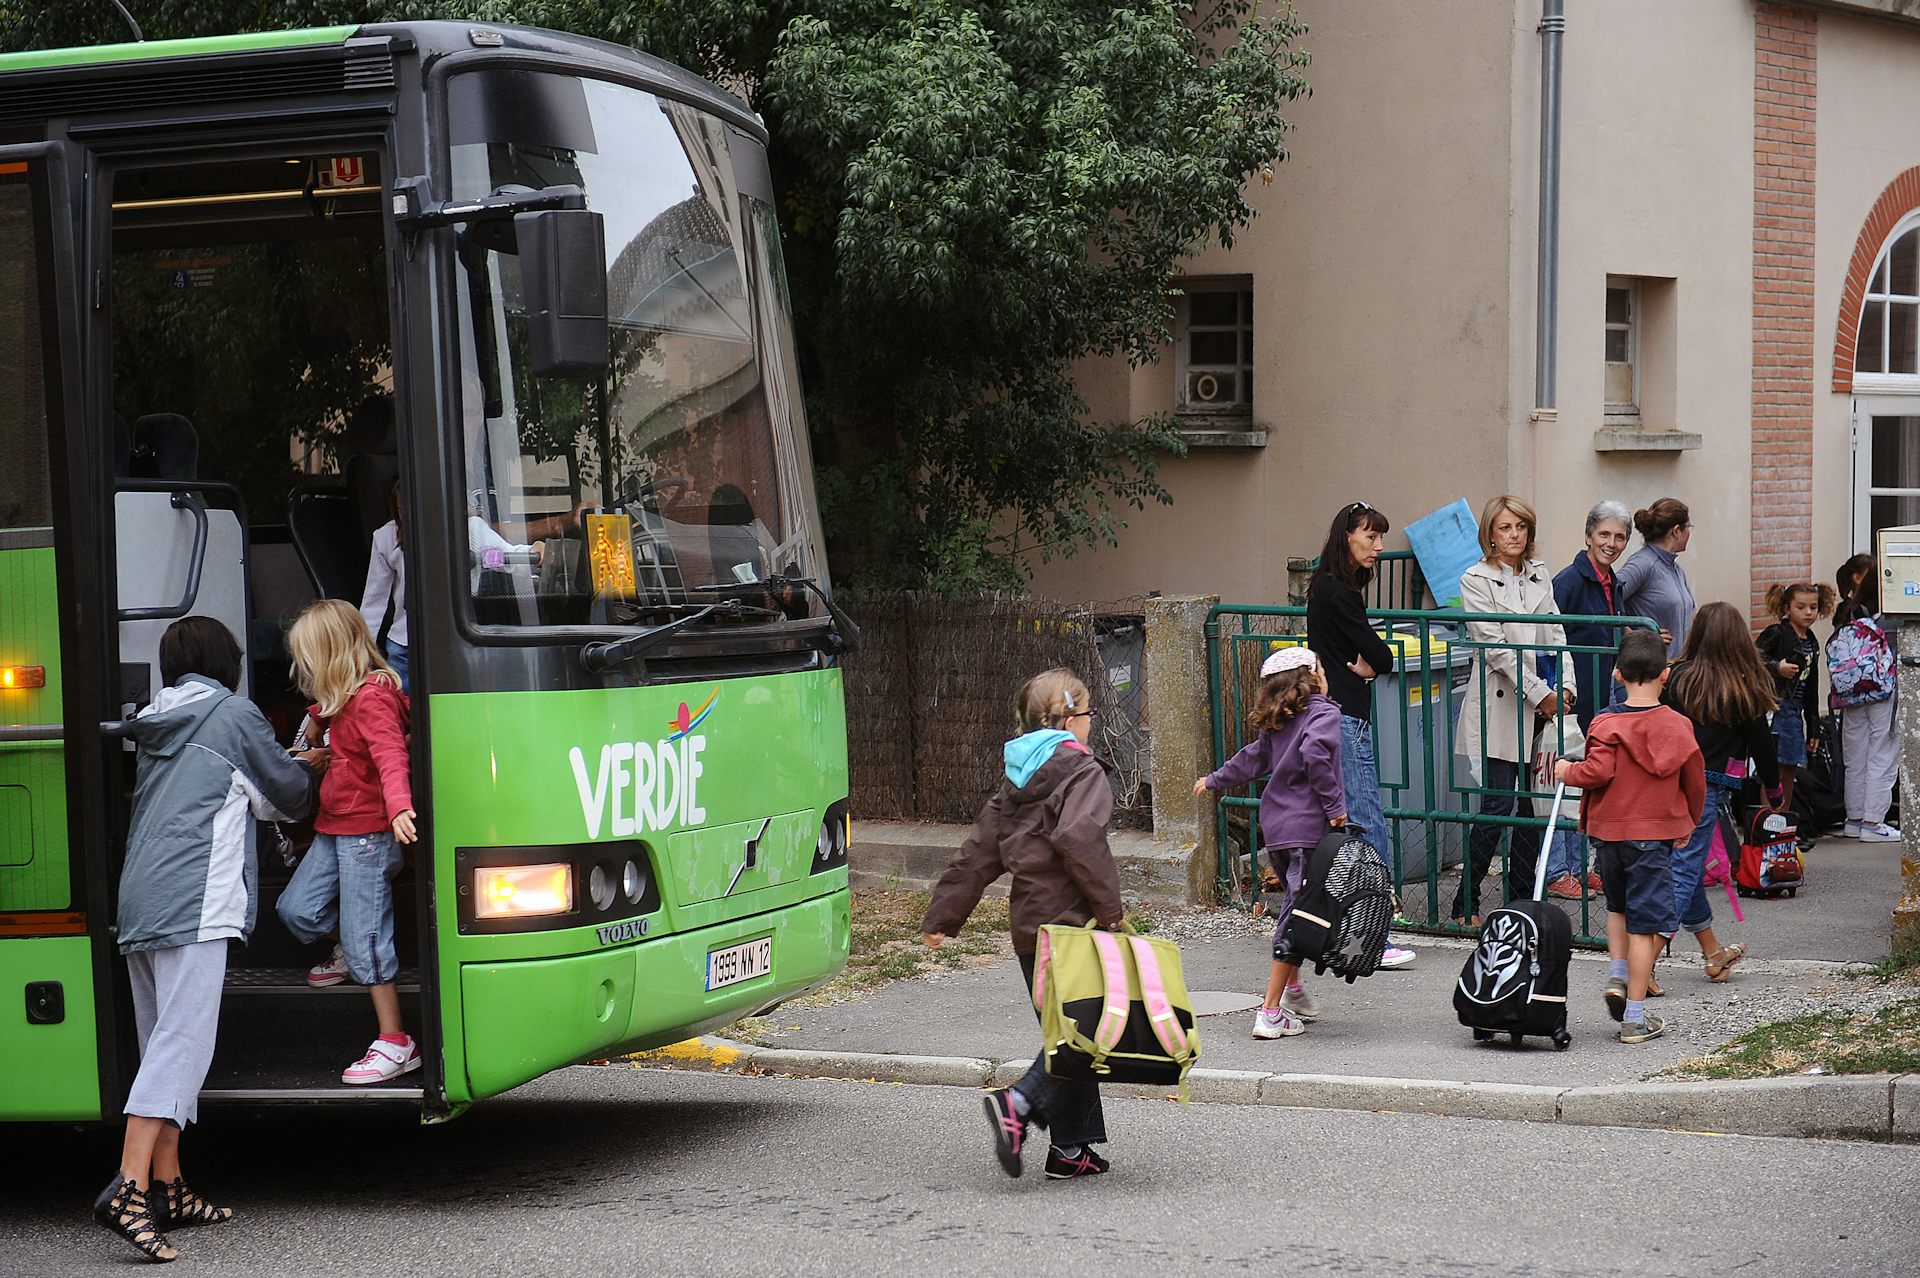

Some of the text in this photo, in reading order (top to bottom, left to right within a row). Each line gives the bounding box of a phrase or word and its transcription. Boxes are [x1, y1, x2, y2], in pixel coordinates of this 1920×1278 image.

[569, 735, 706, 840] VERDIE
[597, 919, 649, 945] VOLVO
[714, 942, 770, 984] 1999 NN 12
